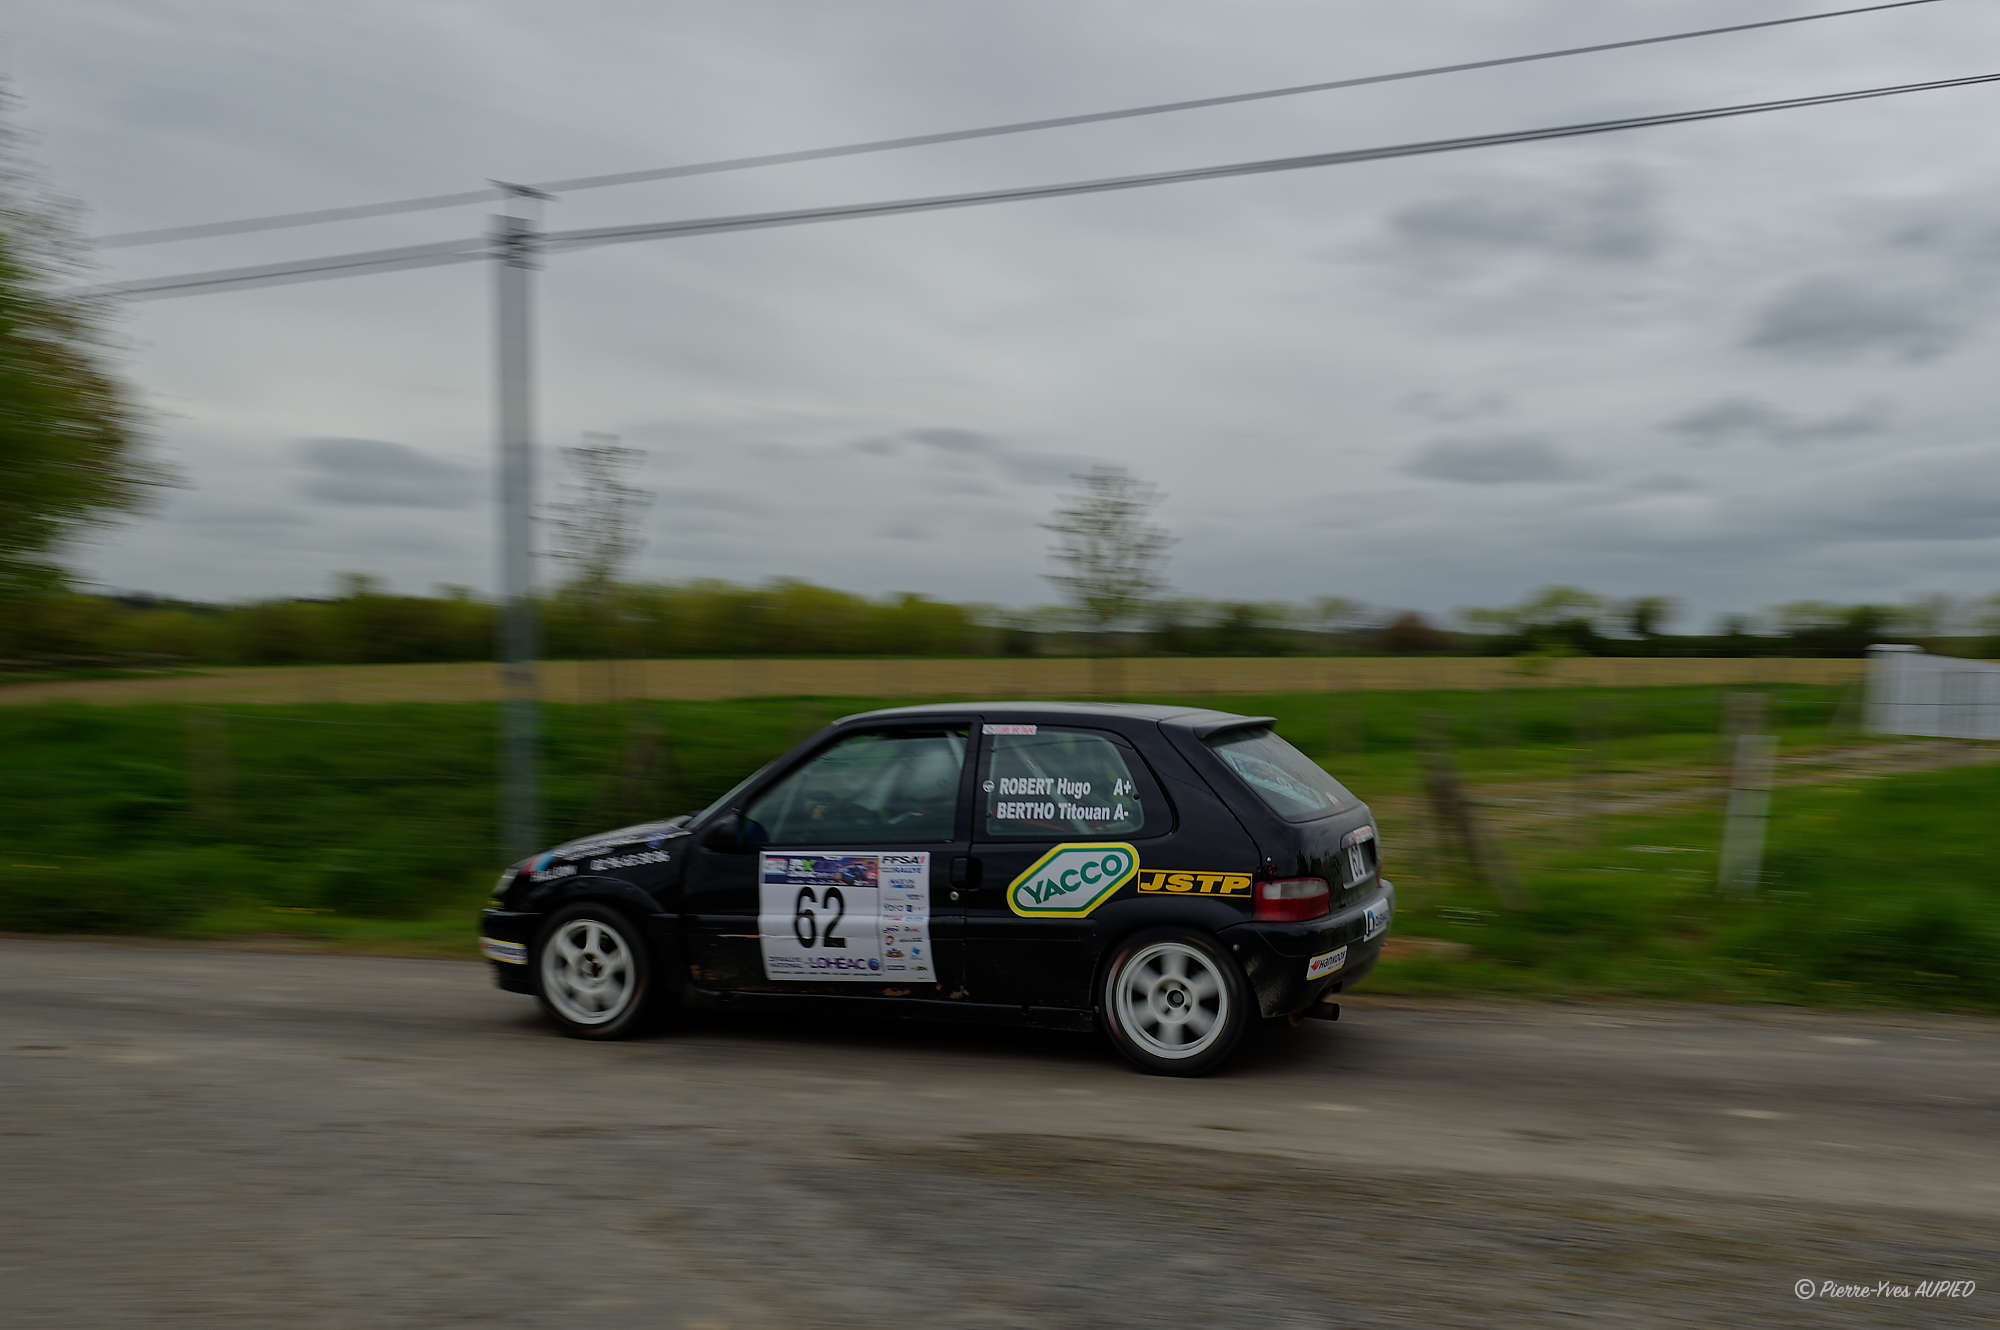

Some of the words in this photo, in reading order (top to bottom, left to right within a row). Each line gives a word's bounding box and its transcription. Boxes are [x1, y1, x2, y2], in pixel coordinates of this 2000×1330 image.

[999, 777, 1054, 796] ROBERT
[1057, 777, 1091, 800] Hugo
[1113, 777, 1132, 796] A+
[996, 802, 1055, 820] BERTHO
[1058, 802, 1110, 820] Titouan
[1113, 803, 1129, 821] A-
[881, 855, 919, 864] FFSA
[1022, 854, 1123, 905] YACCO
[1140, 872, 1251, 894] JSTP
[794, 886, 847, 949] 62
